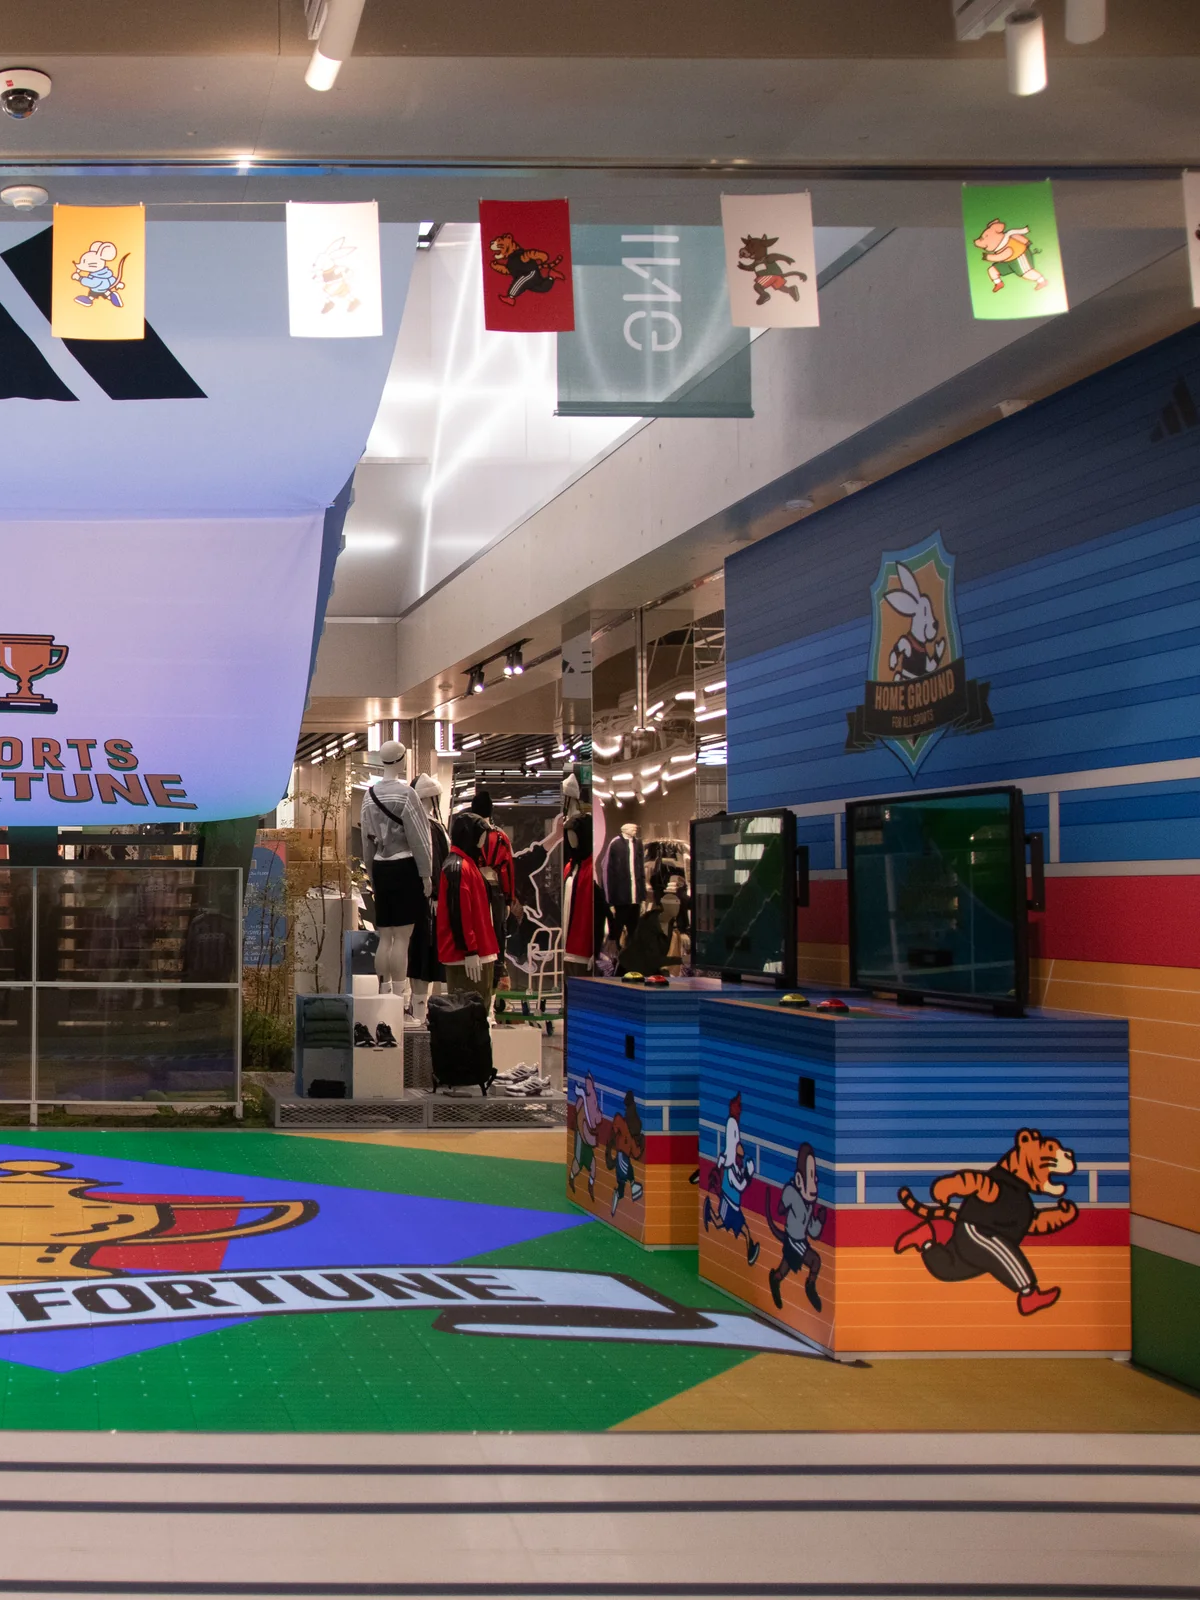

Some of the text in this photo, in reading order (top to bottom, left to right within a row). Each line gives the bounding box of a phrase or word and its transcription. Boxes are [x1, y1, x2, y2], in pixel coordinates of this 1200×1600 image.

[874, 668, 955, 711] HOME GROUND
[892, 709, 935, 728] FOR ALL SPORTS
[7, 1272, 544, 1322] FORTUNE
